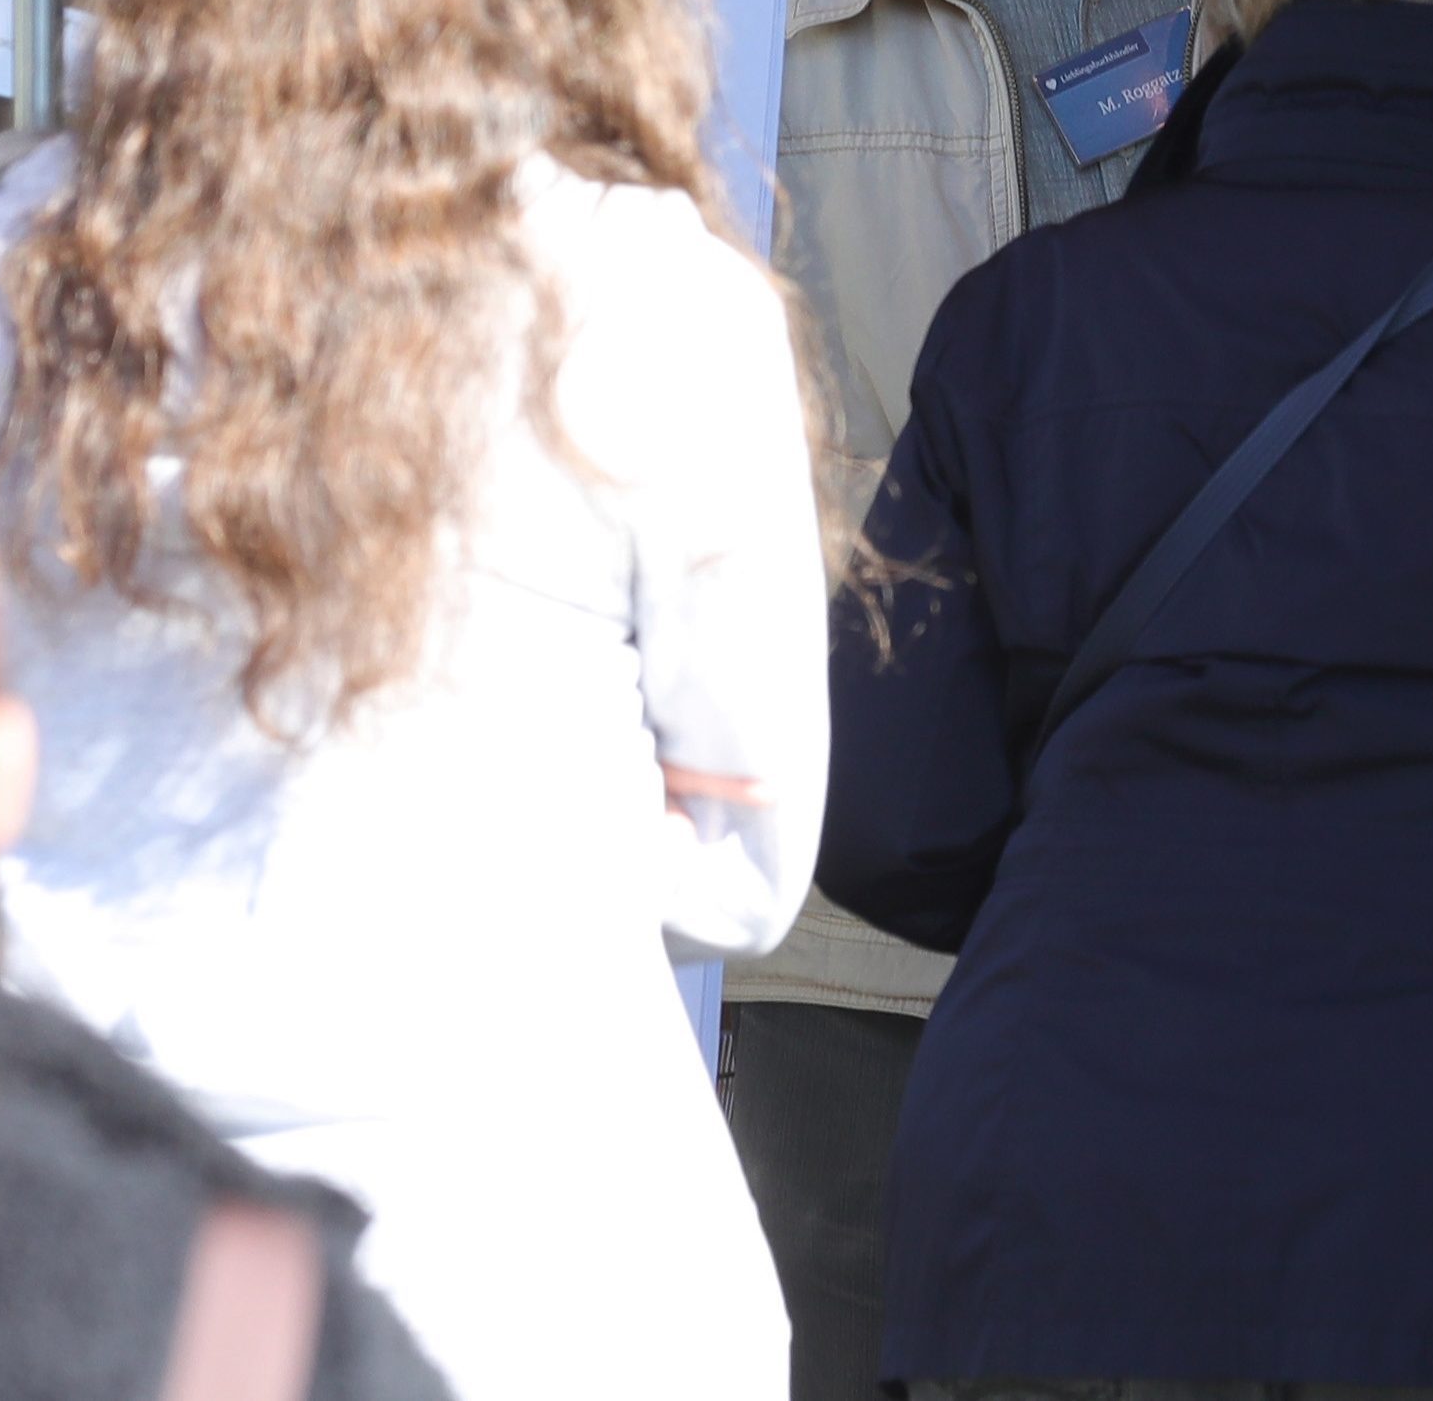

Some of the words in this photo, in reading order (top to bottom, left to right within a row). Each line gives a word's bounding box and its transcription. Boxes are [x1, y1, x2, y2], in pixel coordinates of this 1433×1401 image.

[1059, 42, 1139, 85] Lieblingsbuchhändler
[1097, 96, 1121, 116] M.
[1121, 68, 1184, 105] Roggatz
